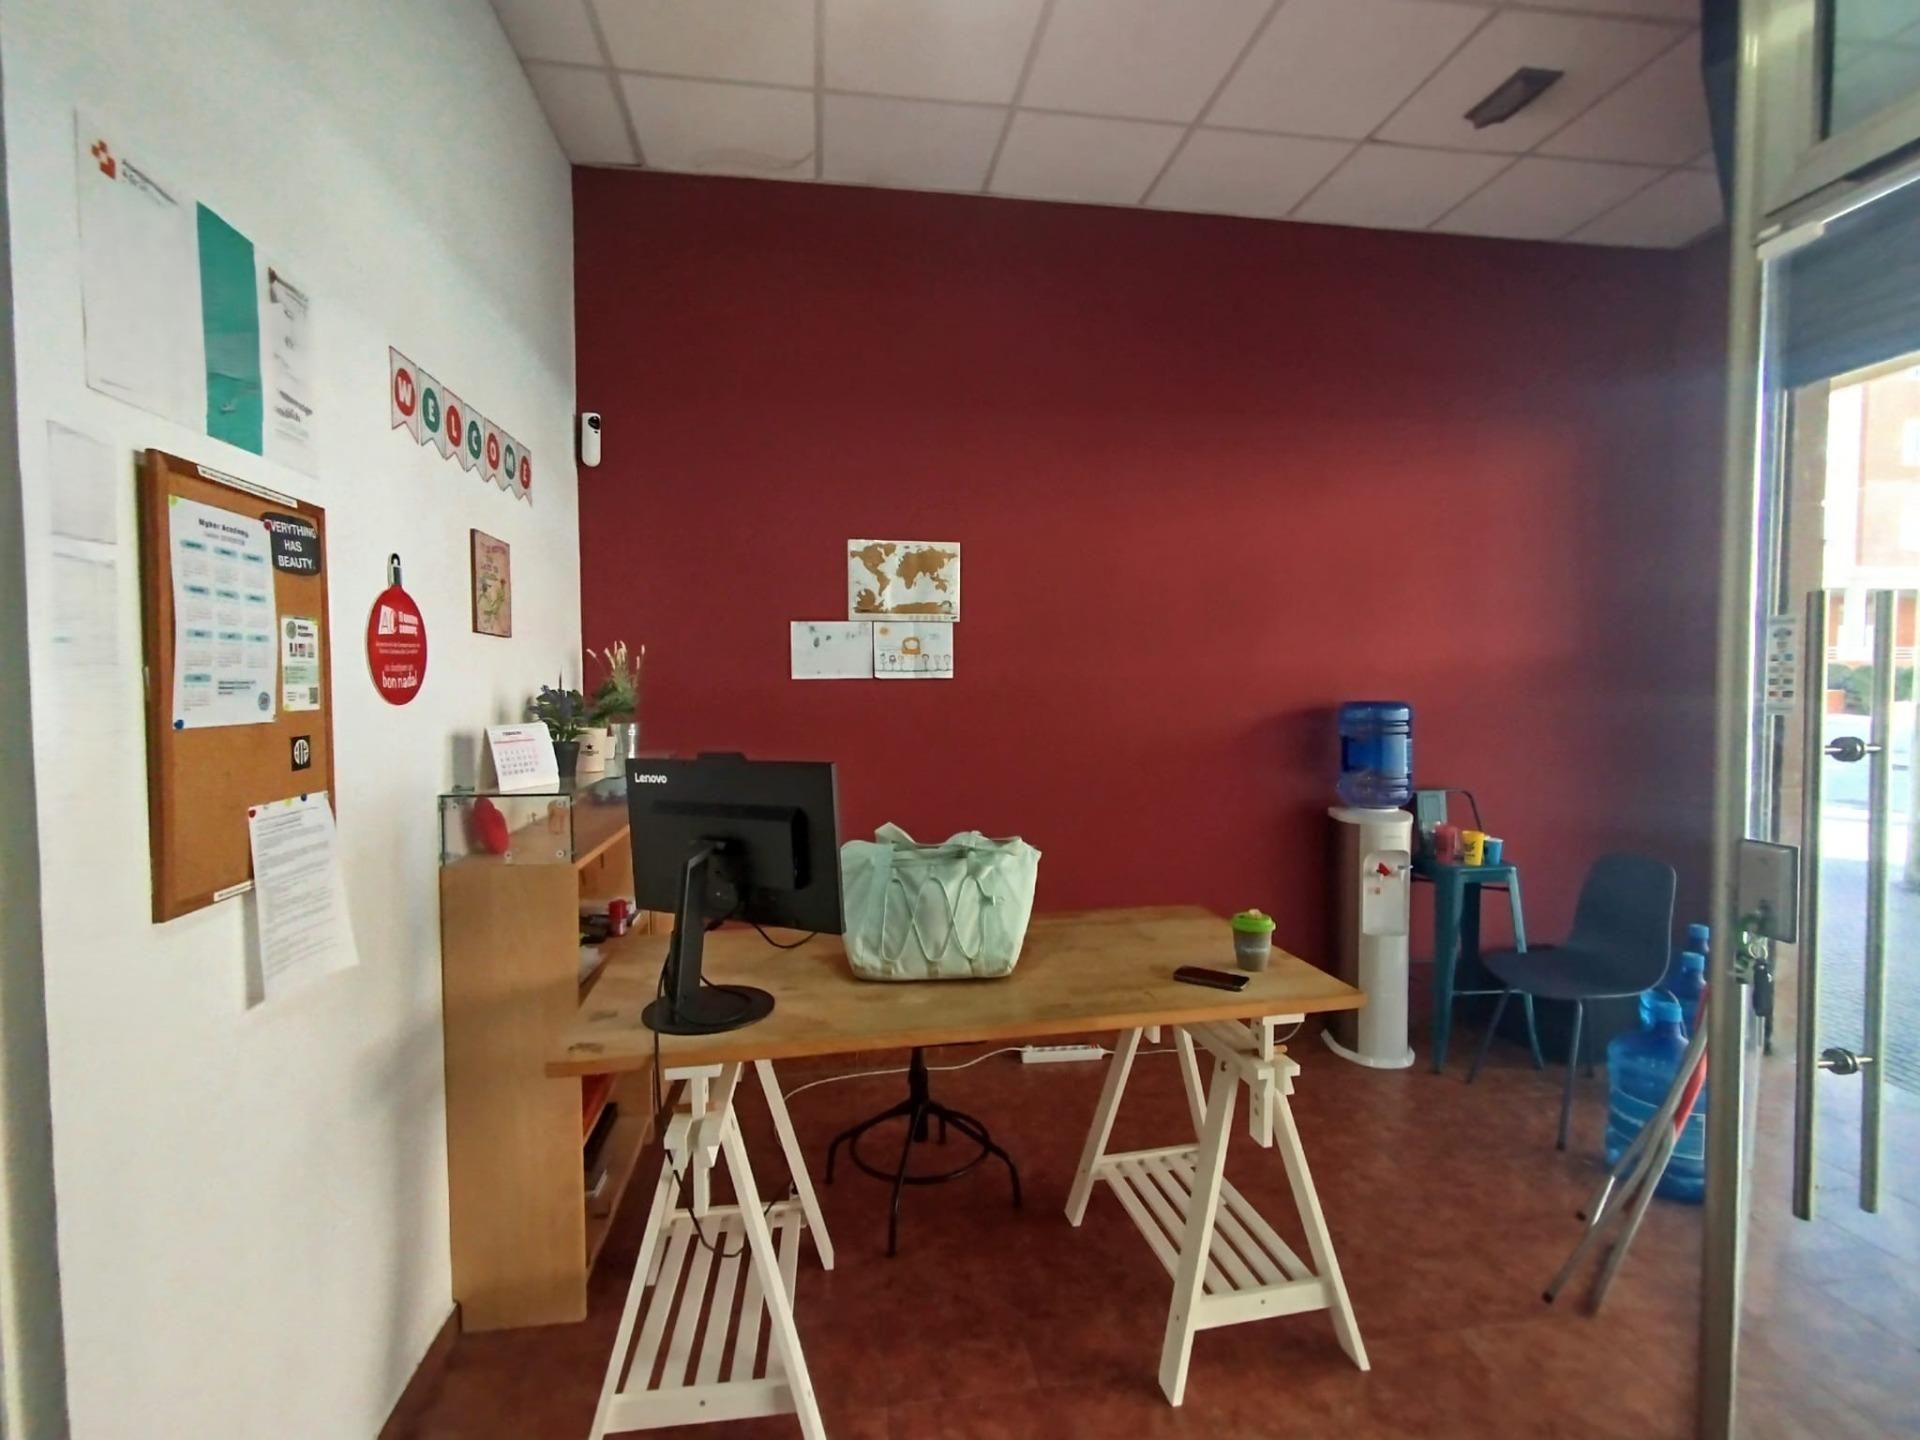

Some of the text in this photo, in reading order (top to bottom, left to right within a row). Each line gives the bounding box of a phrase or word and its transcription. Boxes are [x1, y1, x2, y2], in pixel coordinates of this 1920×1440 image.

[395, 370, 530, 486] WELCOME
[266, 519, 317, 539] VERYTHING
[284, 539, 303, 552] HAS
[634, 772, 668, 784] Lenovo
